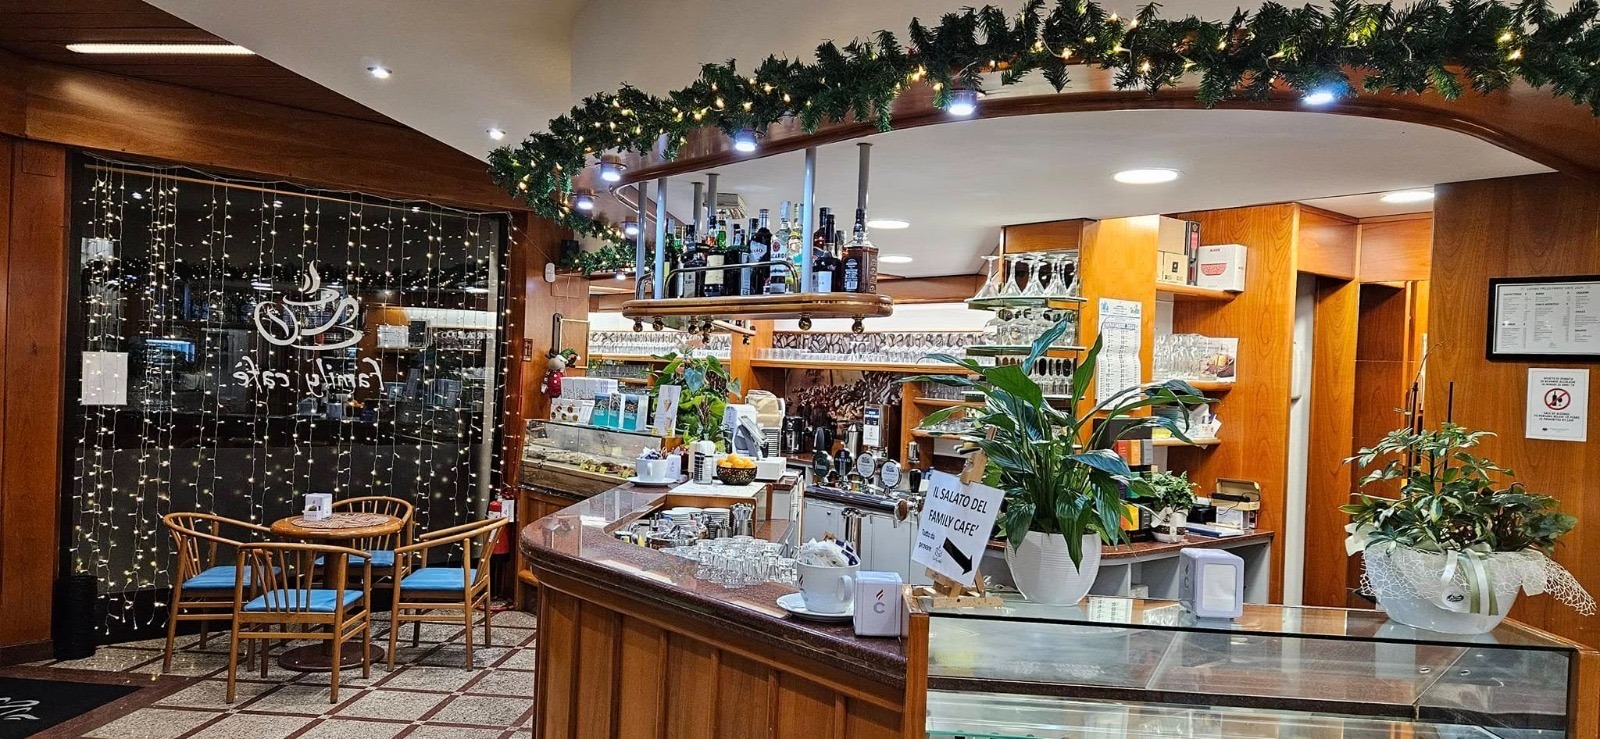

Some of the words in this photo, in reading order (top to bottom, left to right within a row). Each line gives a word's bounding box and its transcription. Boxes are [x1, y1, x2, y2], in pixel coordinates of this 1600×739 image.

[933, 486, 939, 498] IL
[940, 488, 971, 508] SALATO
[971, 498, 987, 514] DEL
[928, 509, 954, 528] FAMILY
[953, 519, 980, 537] CAFE'
[873, 602, 885, 614] C
